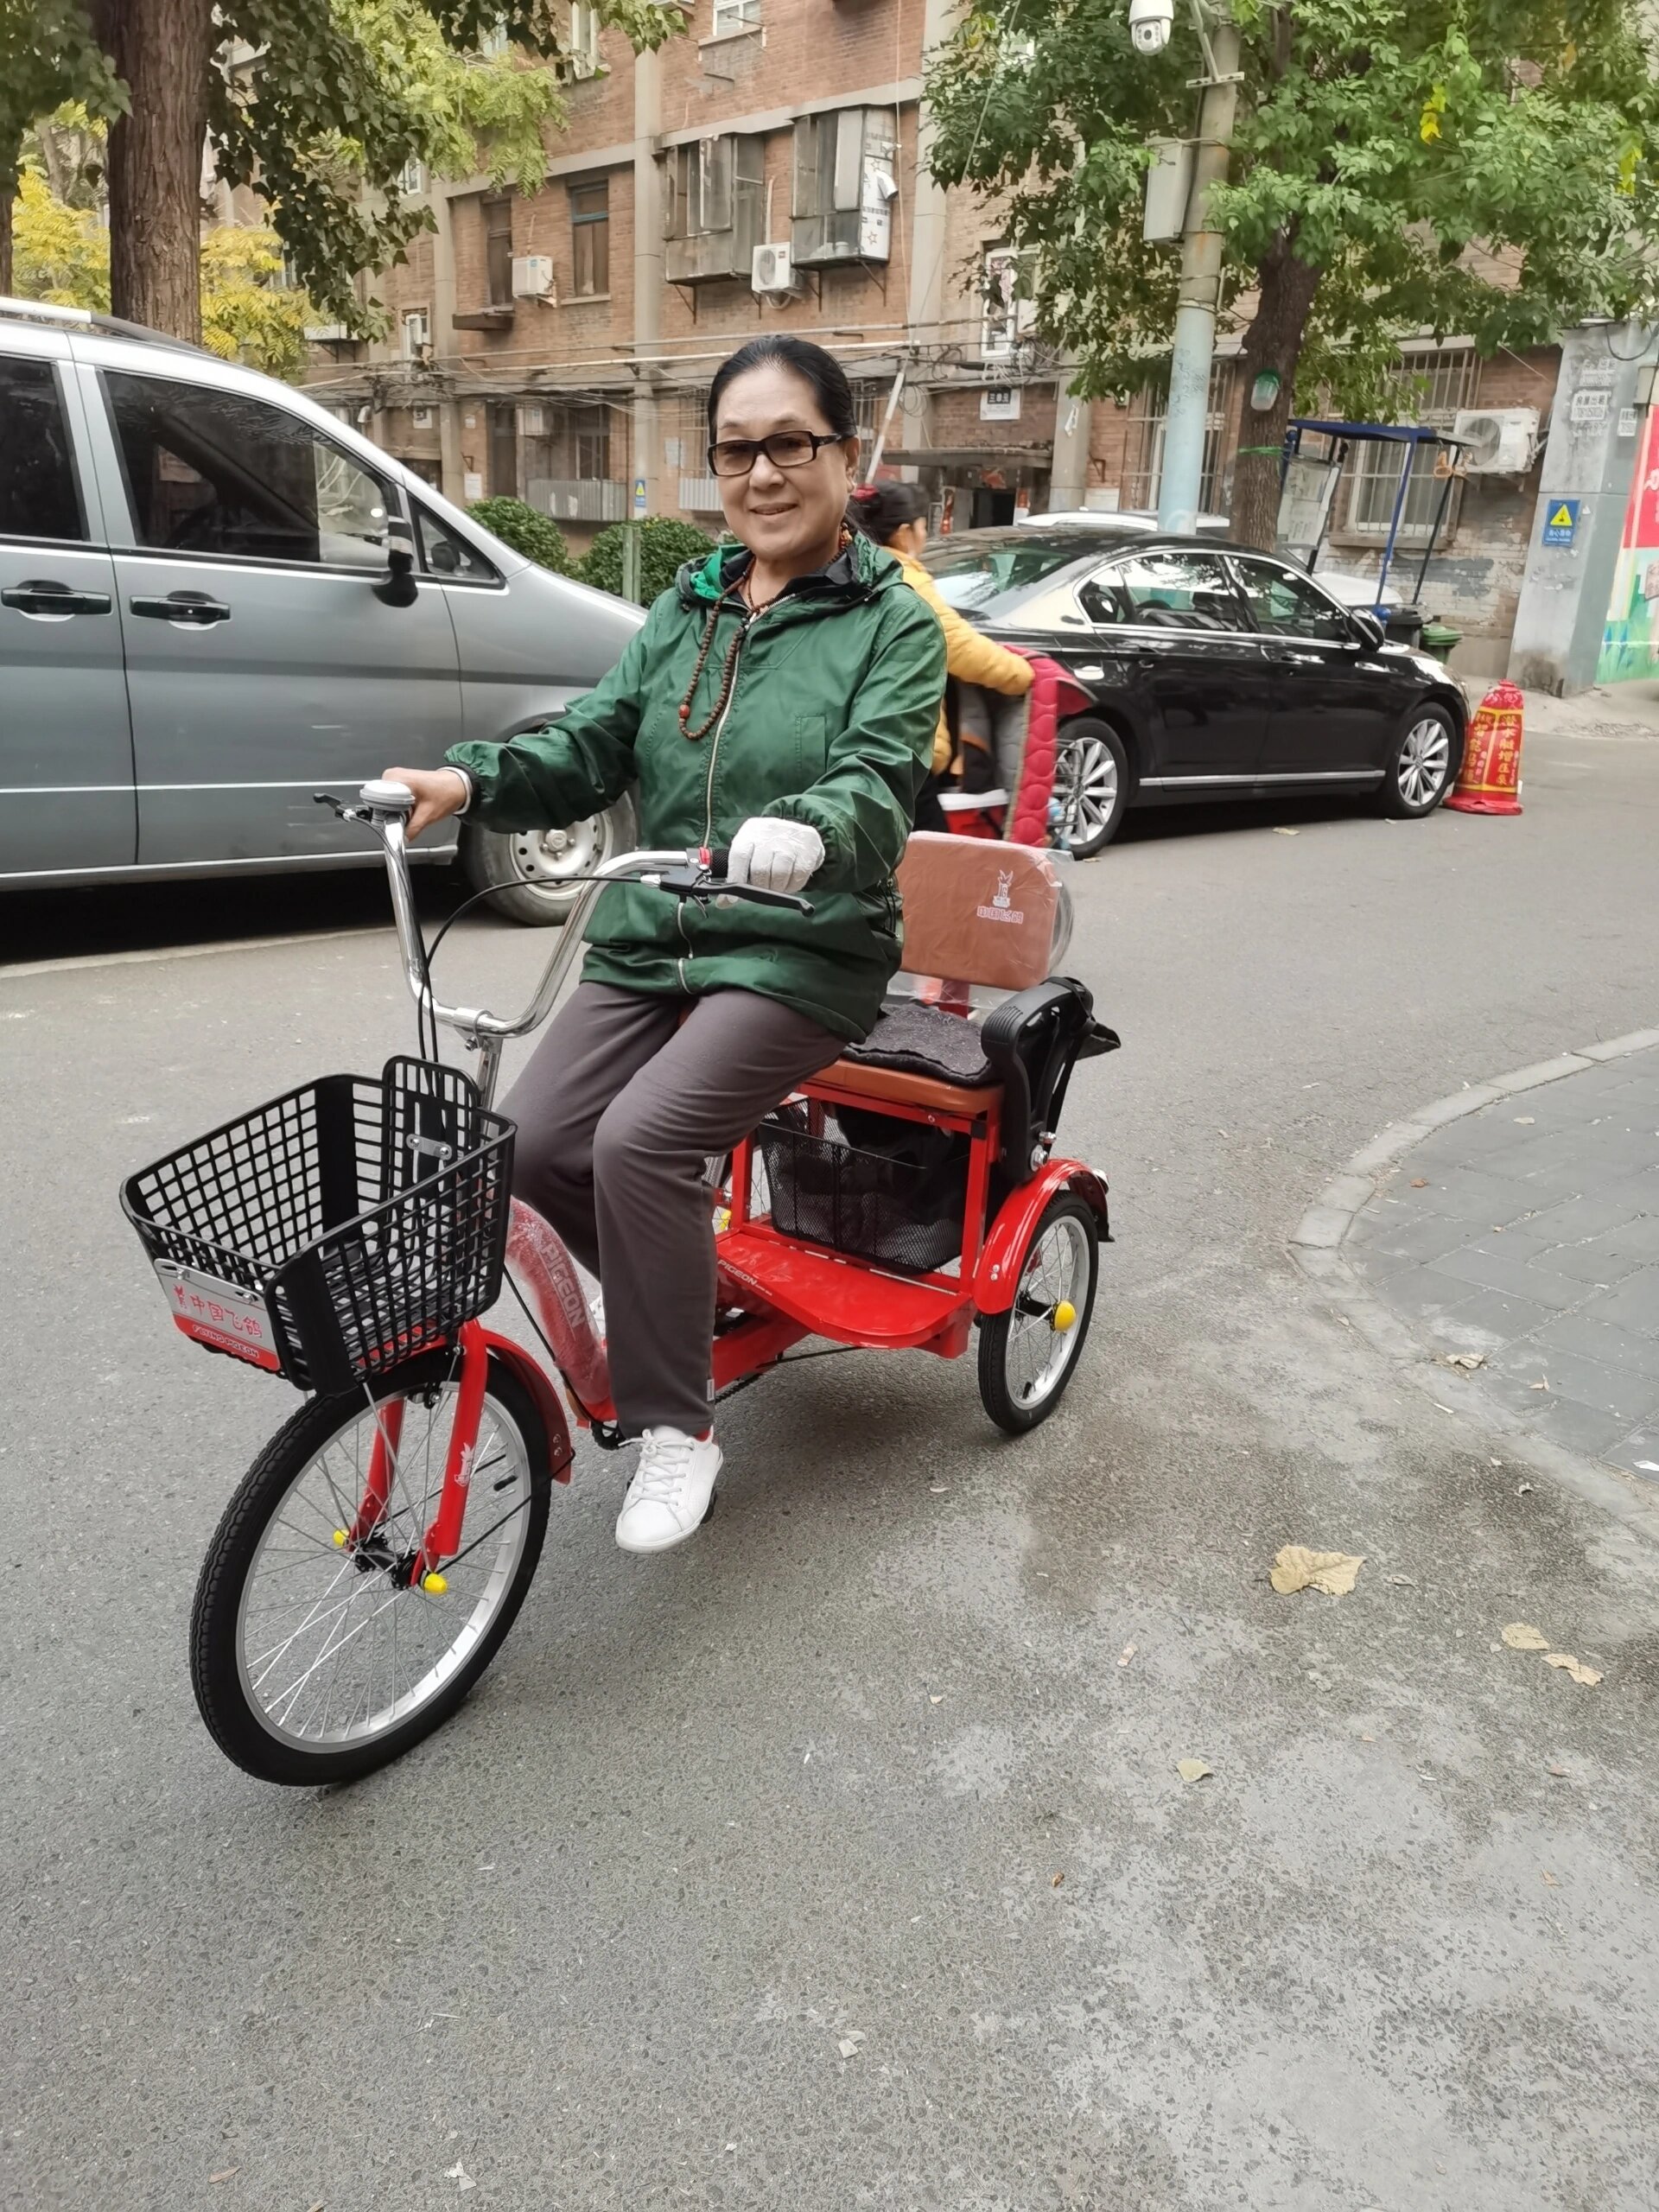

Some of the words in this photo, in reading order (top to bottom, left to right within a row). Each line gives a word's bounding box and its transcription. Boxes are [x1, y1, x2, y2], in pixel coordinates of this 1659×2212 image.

[717, 1259, 758, 1287] PIGEON
[190, 1295, 263, 1338] 中国飞鸽
